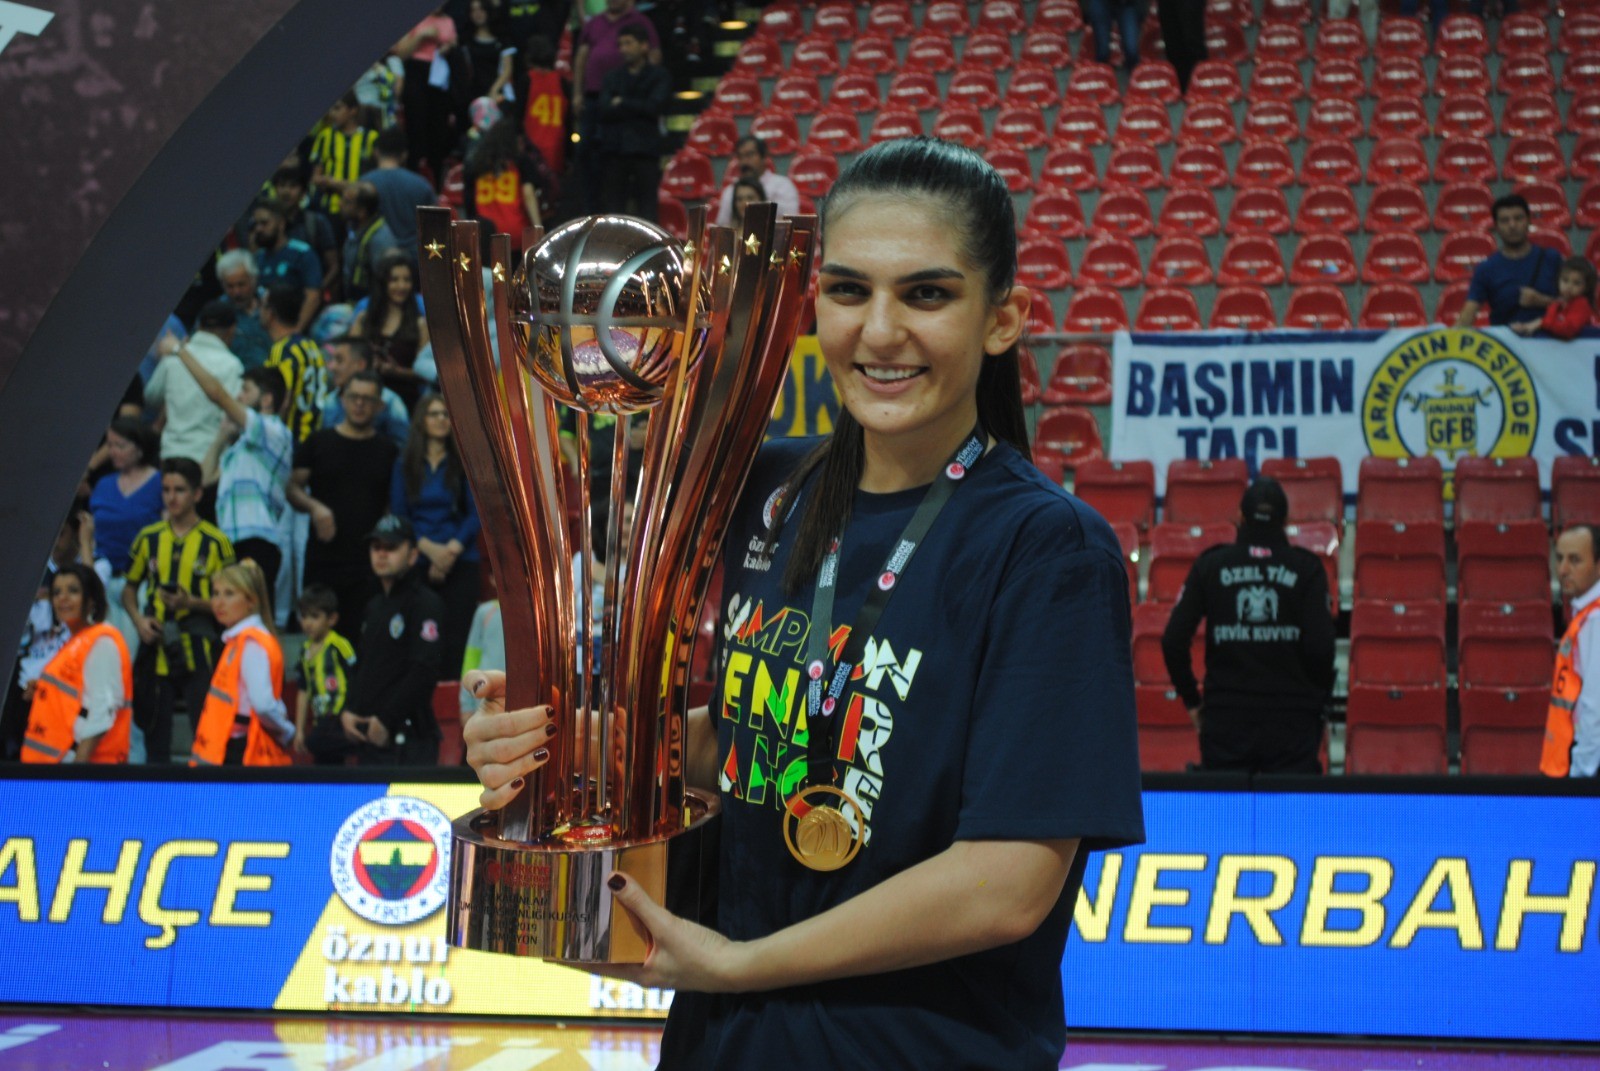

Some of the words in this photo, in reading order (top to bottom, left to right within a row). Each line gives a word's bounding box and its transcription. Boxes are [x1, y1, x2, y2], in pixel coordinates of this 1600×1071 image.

[529, 92, 562, 126] 41
[1126, 359, 1354, 424] BAŞIMIN
[1370, 335, 1448, 441] ARMANIN
[1459, 334, 1530, 437] PEŞİNDE
[1430, 416, 1476, 444] GFB
[324, 964, 452, 1005] kablo
